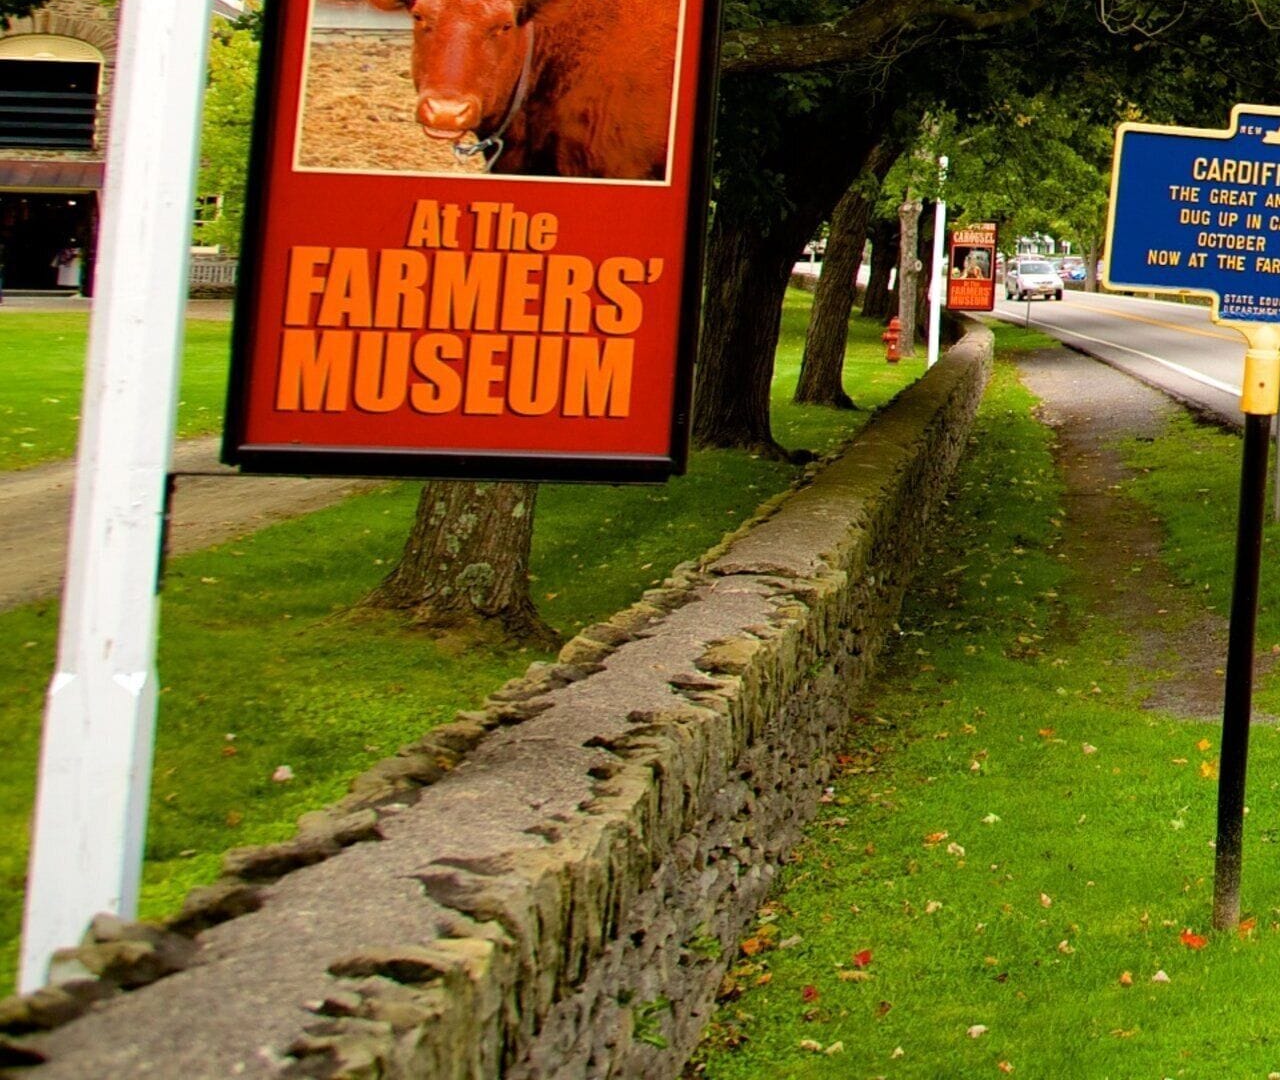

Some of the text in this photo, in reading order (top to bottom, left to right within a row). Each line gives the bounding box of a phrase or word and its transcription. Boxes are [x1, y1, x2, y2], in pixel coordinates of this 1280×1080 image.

[1239, 125, 1263, 136] NEW
[1169, 185, 1201, 203] THE
[1209, 189, 1257, 207] GREAT
[407, 199, 559, 252] At The
[1179, 208, 1211, 226] DUG
[1218, 211, 1239, 227] UP
[1246, 214, 1262, 230] IN
[953, 231, 996, 244] CAROUSEL
[1197, 232, 1266, 252] OCTOBER
[1147, 249, 1181, 267] NOW
[1187, 251, 1209, 268] AT
[1217, 254, 1246, 271] THE
[284, 245, 665, 335] FARMERS'
[1223, 293, 1255, 305] STATE
[274, 328, 636, 419] MUSEUM
